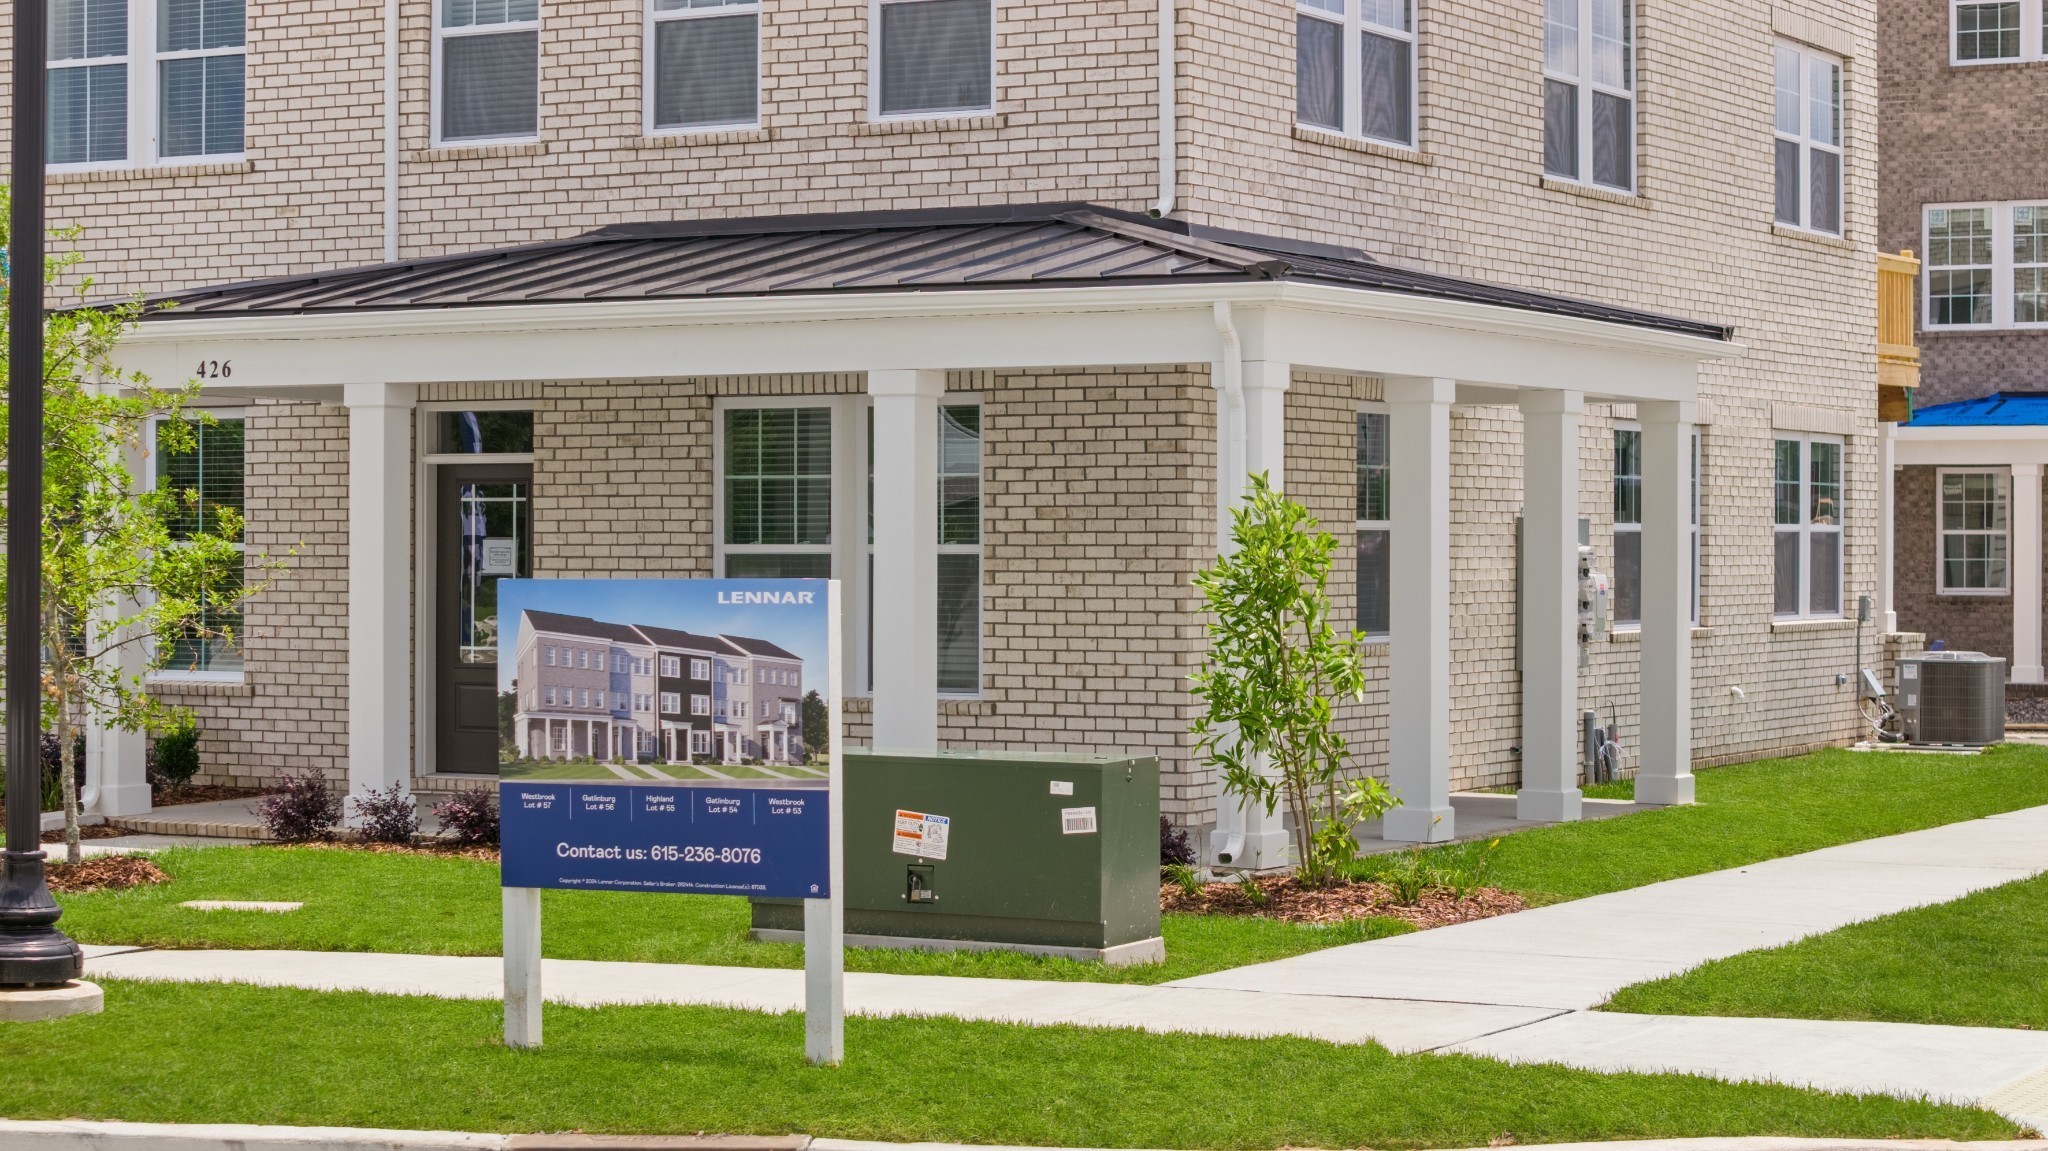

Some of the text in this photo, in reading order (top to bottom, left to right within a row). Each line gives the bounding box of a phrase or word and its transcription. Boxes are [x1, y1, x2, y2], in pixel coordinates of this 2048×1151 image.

[196, 360, 232, 378] 426
[718, 591, 814, 604] LENNAR
[521, 793, 555, 801] Westbrook
[582, 794, 616, 804] Gatlinburg
[646, 795, 674, 804] Highland
[706, 797, 741, 806] Gatlinburg
[768, 797, 805, 806] Westbrook
[556, 842, 761, 864] Contact us: 615-236-8076
